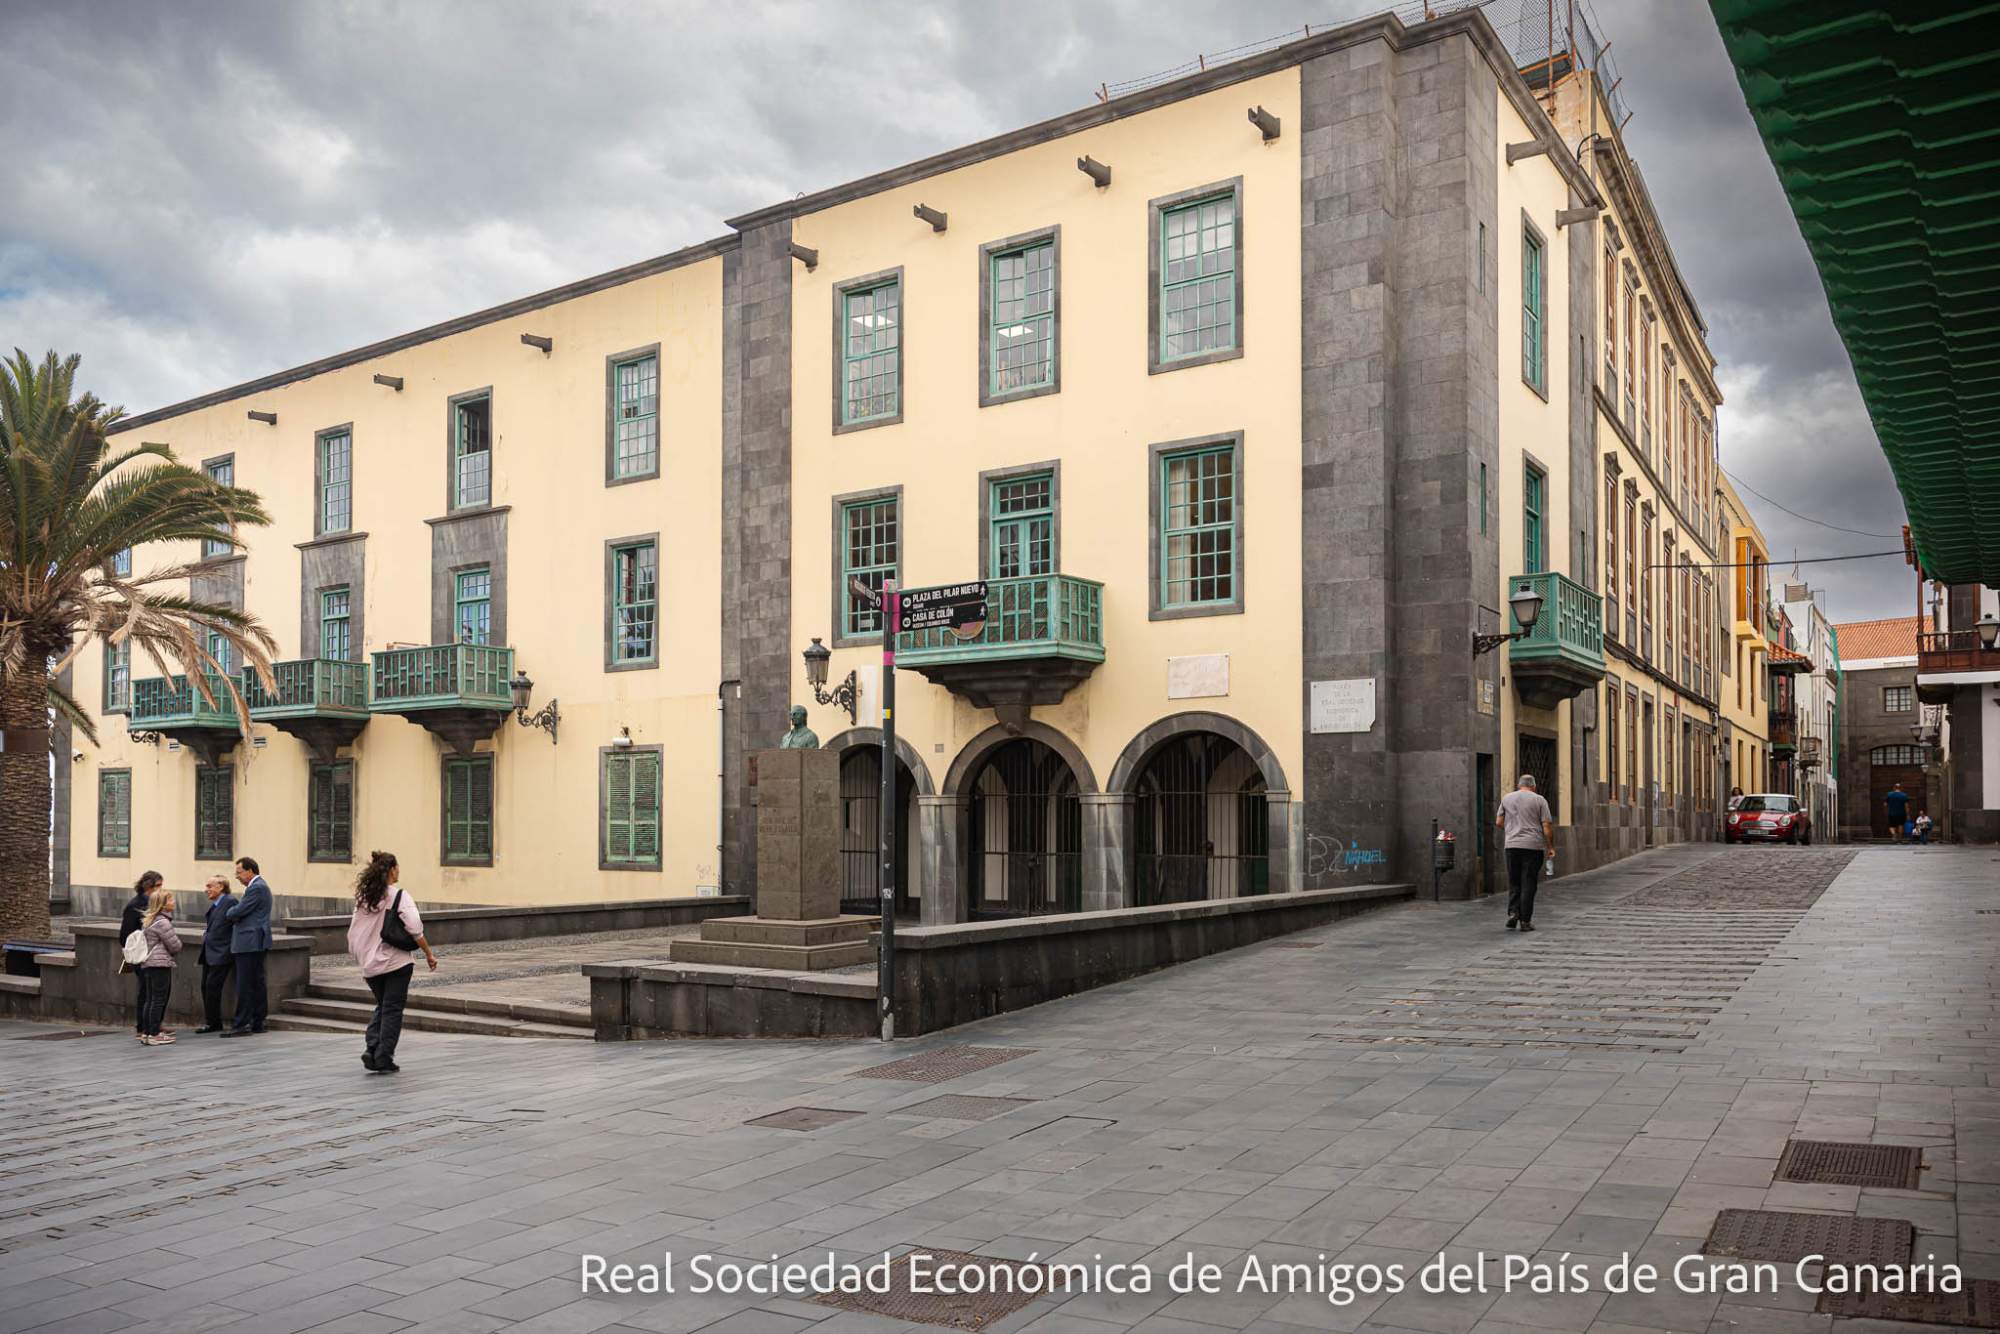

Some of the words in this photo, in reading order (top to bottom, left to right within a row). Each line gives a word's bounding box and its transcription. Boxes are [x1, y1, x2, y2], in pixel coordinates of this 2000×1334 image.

[912, 592, 932, 603] PLAZA
[932, 590, 942, 600] DEL
[943, 587, 960, 598] PILAR
[960, 583, 979, 595] NUEVO
[912, 612, 928, 623] CASA
[928, 611, 937, 620] DE
[937, 606, 954, 619] COLÓN
